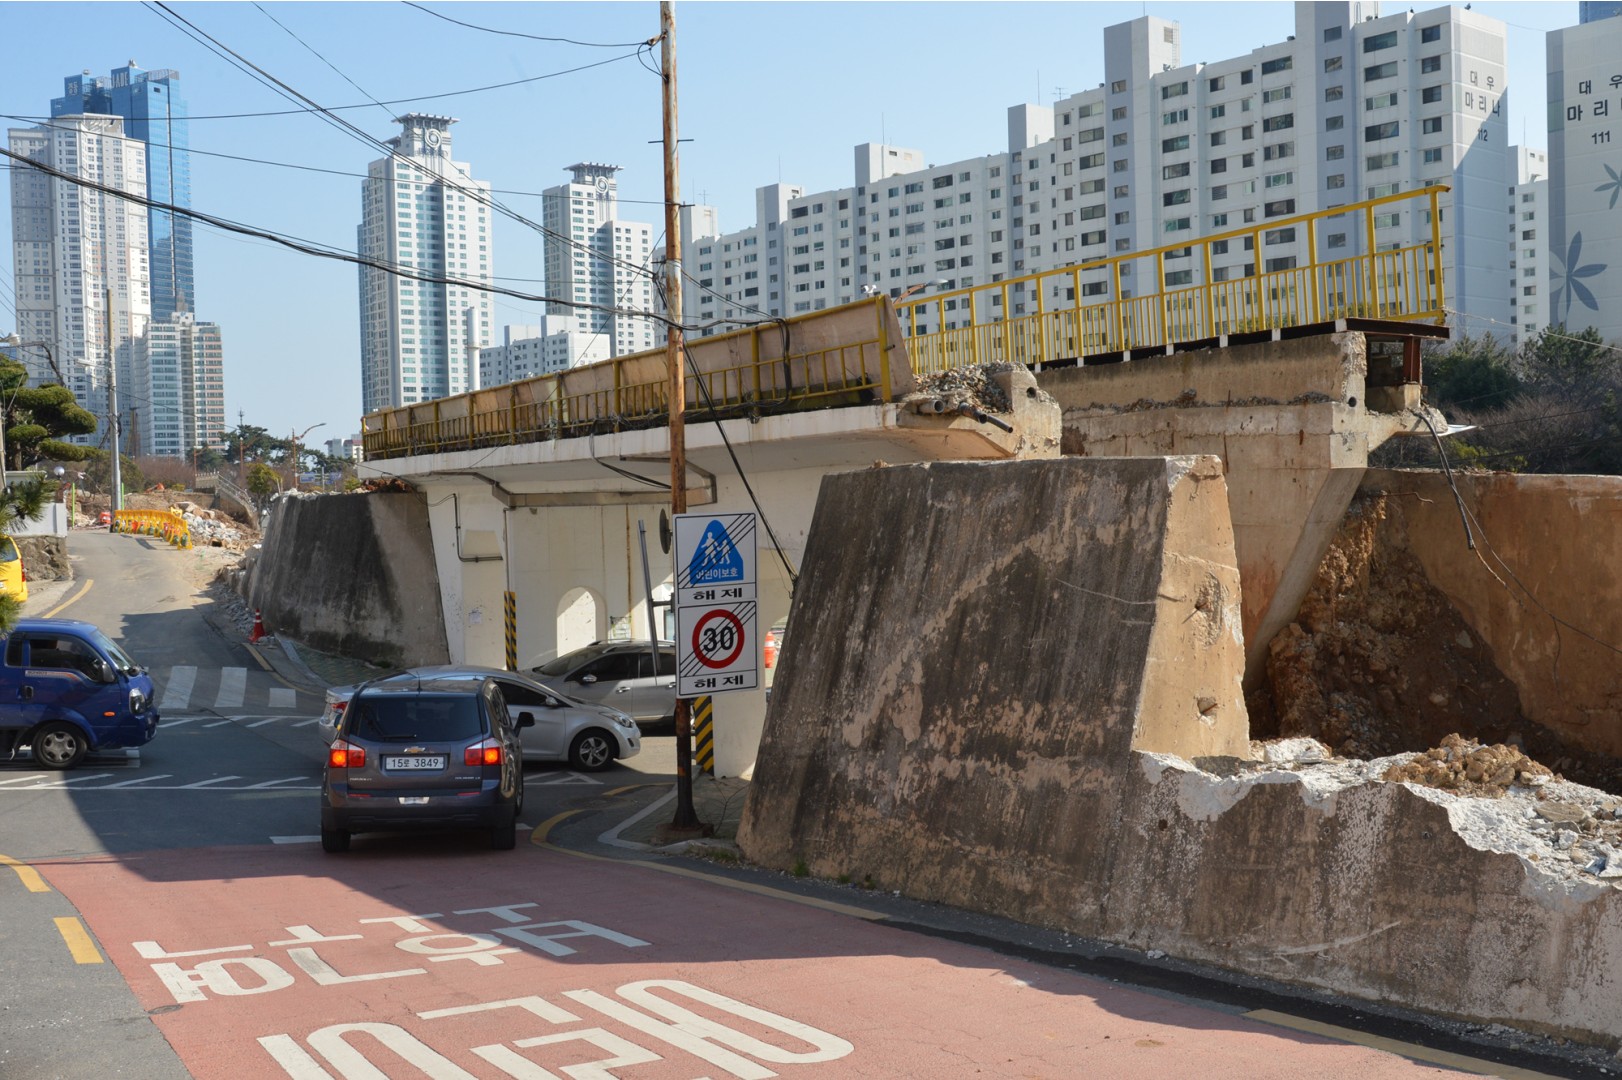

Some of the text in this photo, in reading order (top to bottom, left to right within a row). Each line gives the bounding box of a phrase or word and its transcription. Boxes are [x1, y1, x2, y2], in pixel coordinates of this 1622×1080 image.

[1470, 70, 1495, 90] 대우
[1579, 74, 1622, 95] 대우
[1465, 91, 1500, 117] 마리나
[1567, 98, 1622, 122] 마리
[1477, 128, 1488, 142] 112
[1591, 130, 1610, 145] 111
[696, 567, 738, 580] 어린이보호
[693, 587, 742, 600] 해제
[703, 625, 734, 653] 30
[694, 675, 743, 688] 해제
[414, 758, 439, 768] 3849
